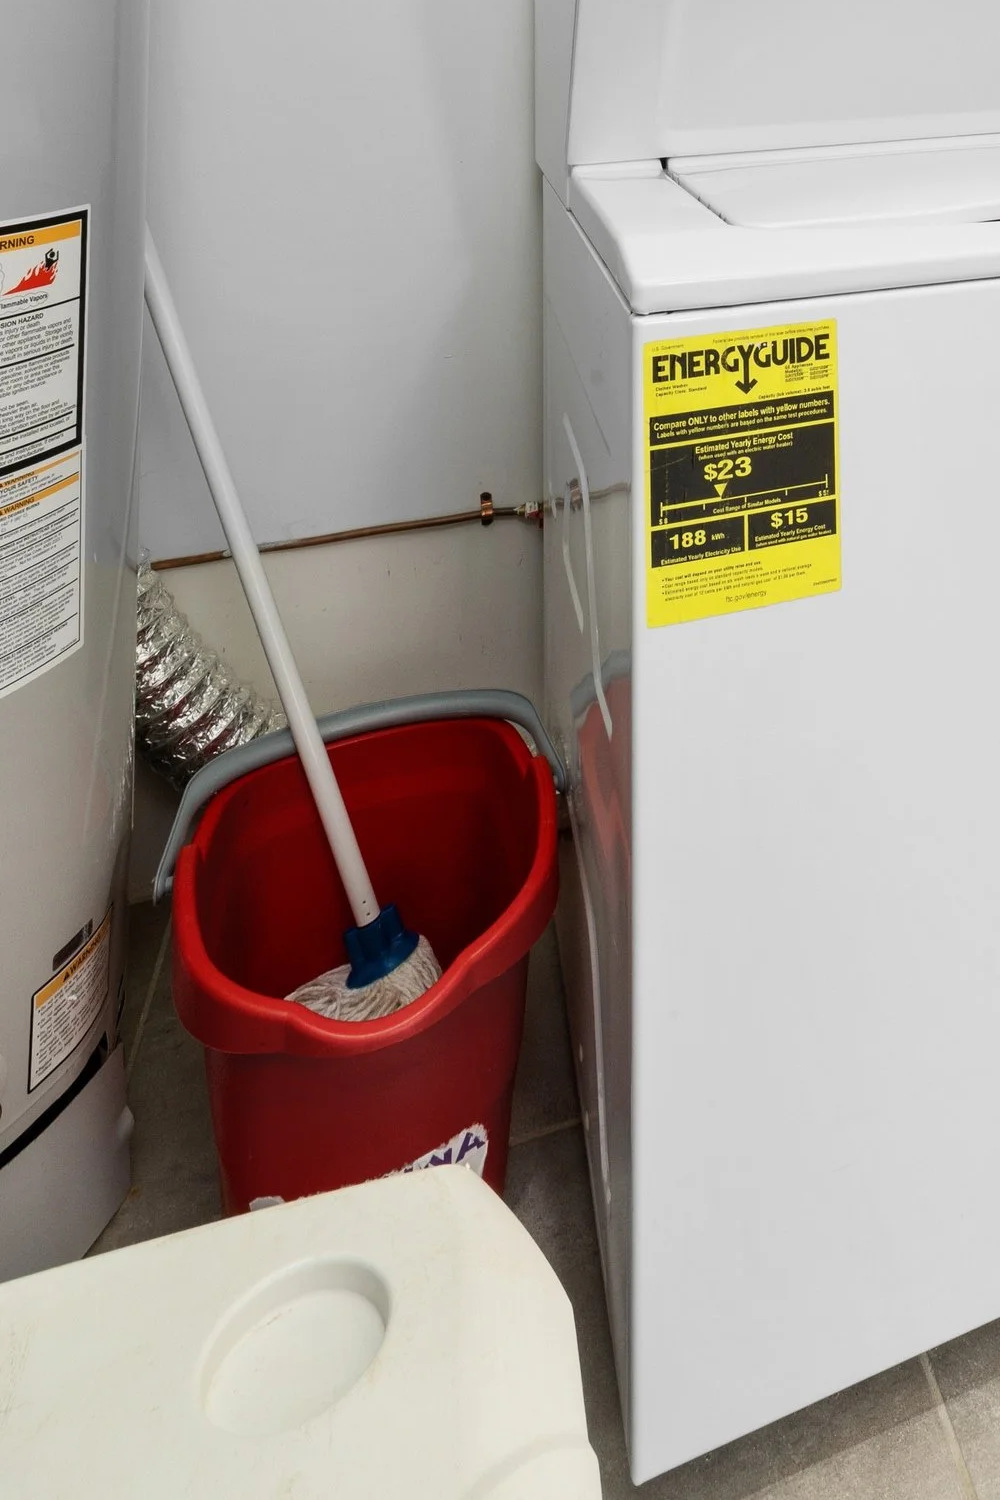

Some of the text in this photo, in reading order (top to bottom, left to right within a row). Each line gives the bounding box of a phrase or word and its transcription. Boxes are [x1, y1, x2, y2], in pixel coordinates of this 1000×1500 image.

[29, 294, 49, 304] Vapors
[18, 312, 44, 325] HAZARD
[652, 333, 830, 384] ENERGYGUIDE
[653, 419, 687, 433] Compare
[687, 414, 709, 427] ONLY
[709, 414, 717, 422] to
[718, 411, 737, 422] other
[738, 407, 759, 420] labels
[760, 405, 775, 415] with
[775, 402, 798, 415] yellow
[656, 430, 675, 440] Labels
[675, 428, 687, 437] with
[688, 426, 706, 436] yellow
[695, 431, 793, 455] Estimated Yearly Energy Cost
[703, 456, 752, 482] $23
[770, 507, 809, 530] $15
[669, 529, 726, 551] 188 kWh
[755, 532, 780, 543] Estimated
[661, 556, 687, 566] Estimated
